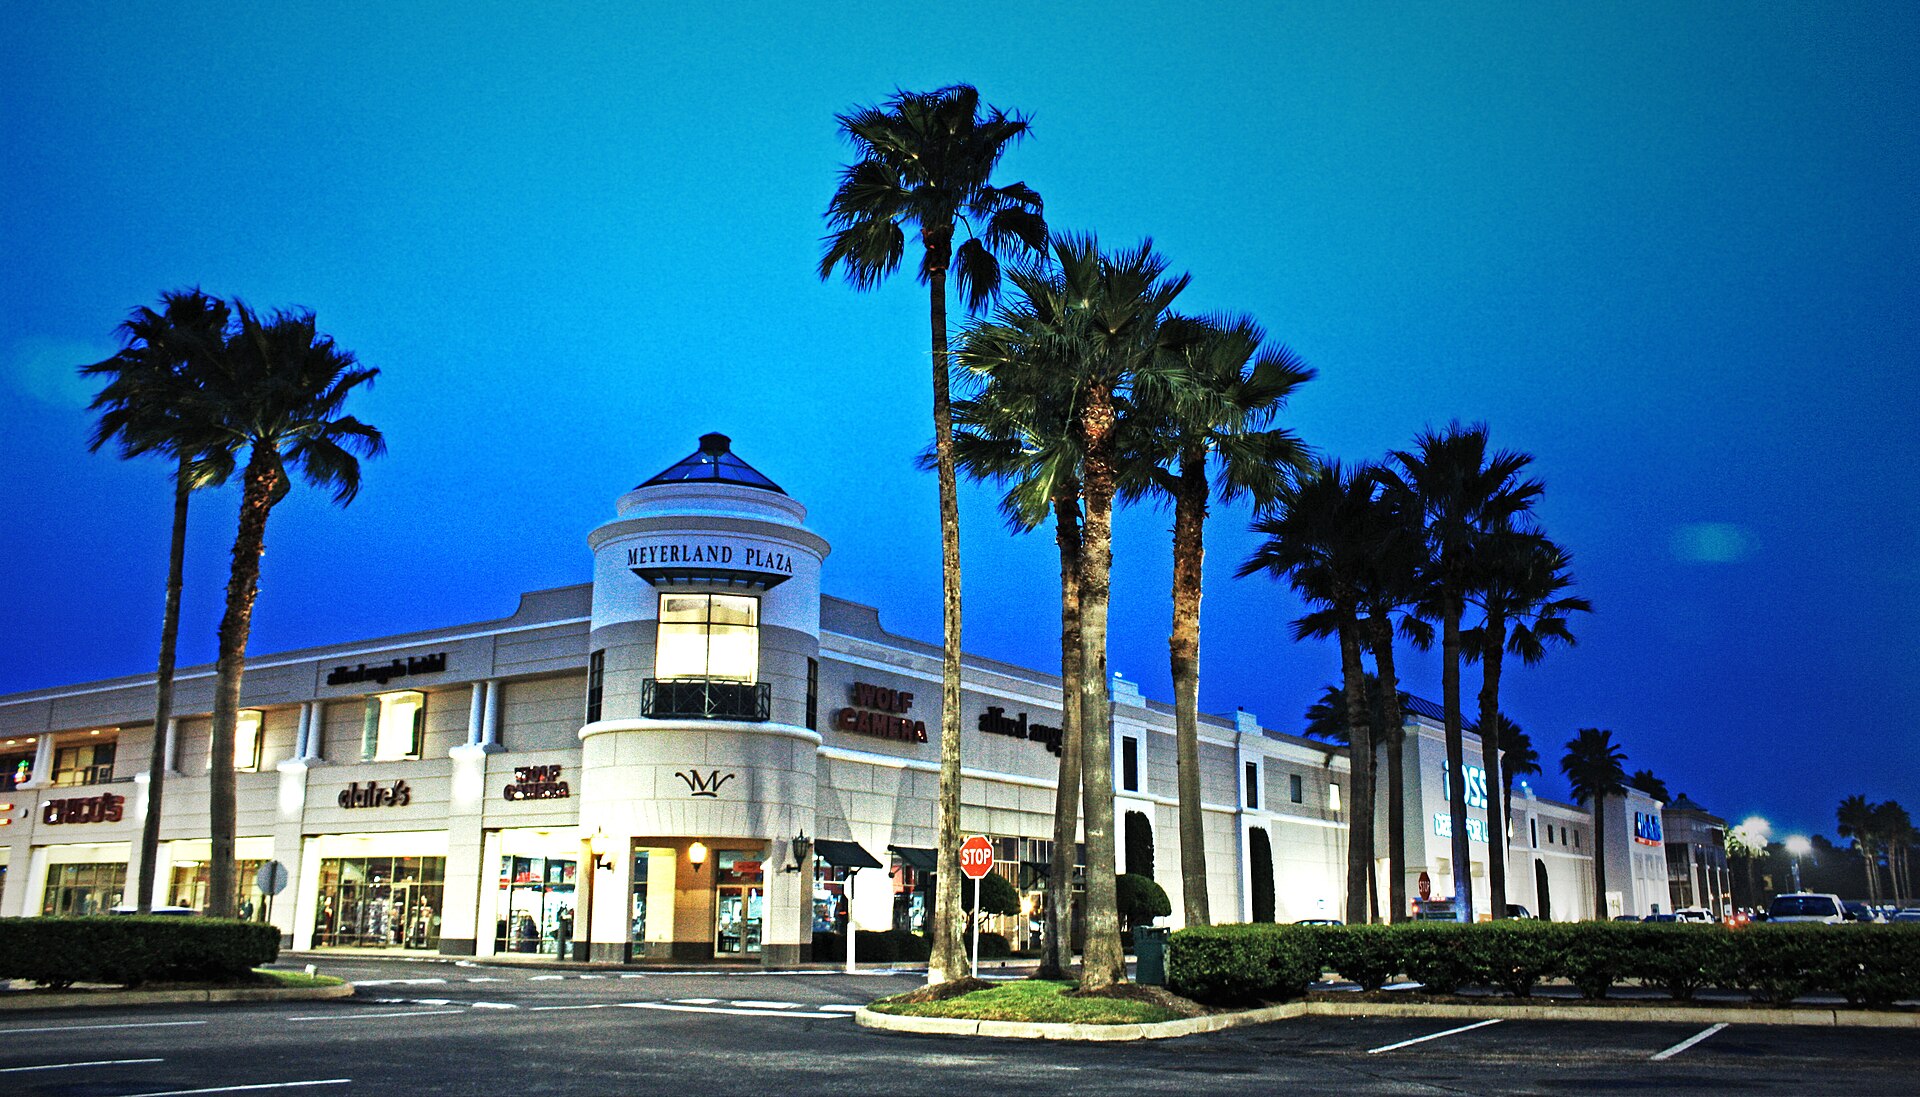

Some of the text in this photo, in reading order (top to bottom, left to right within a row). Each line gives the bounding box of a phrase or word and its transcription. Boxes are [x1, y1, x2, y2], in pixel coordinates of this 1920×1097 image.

[627, 545, 793, 573] MEYERLAND PLAZA
[853, 682, 914, 714] WOLF
[837, 707, 928, 743] CAMERA
[978, 706, 1028, 739] alfred
[338, 780, 411, 809] claire's
[503, 782, 569, 801] CAMERA
[961, 848, 992, 866] STOP
[1419, 880, 1431, 893] STOP
